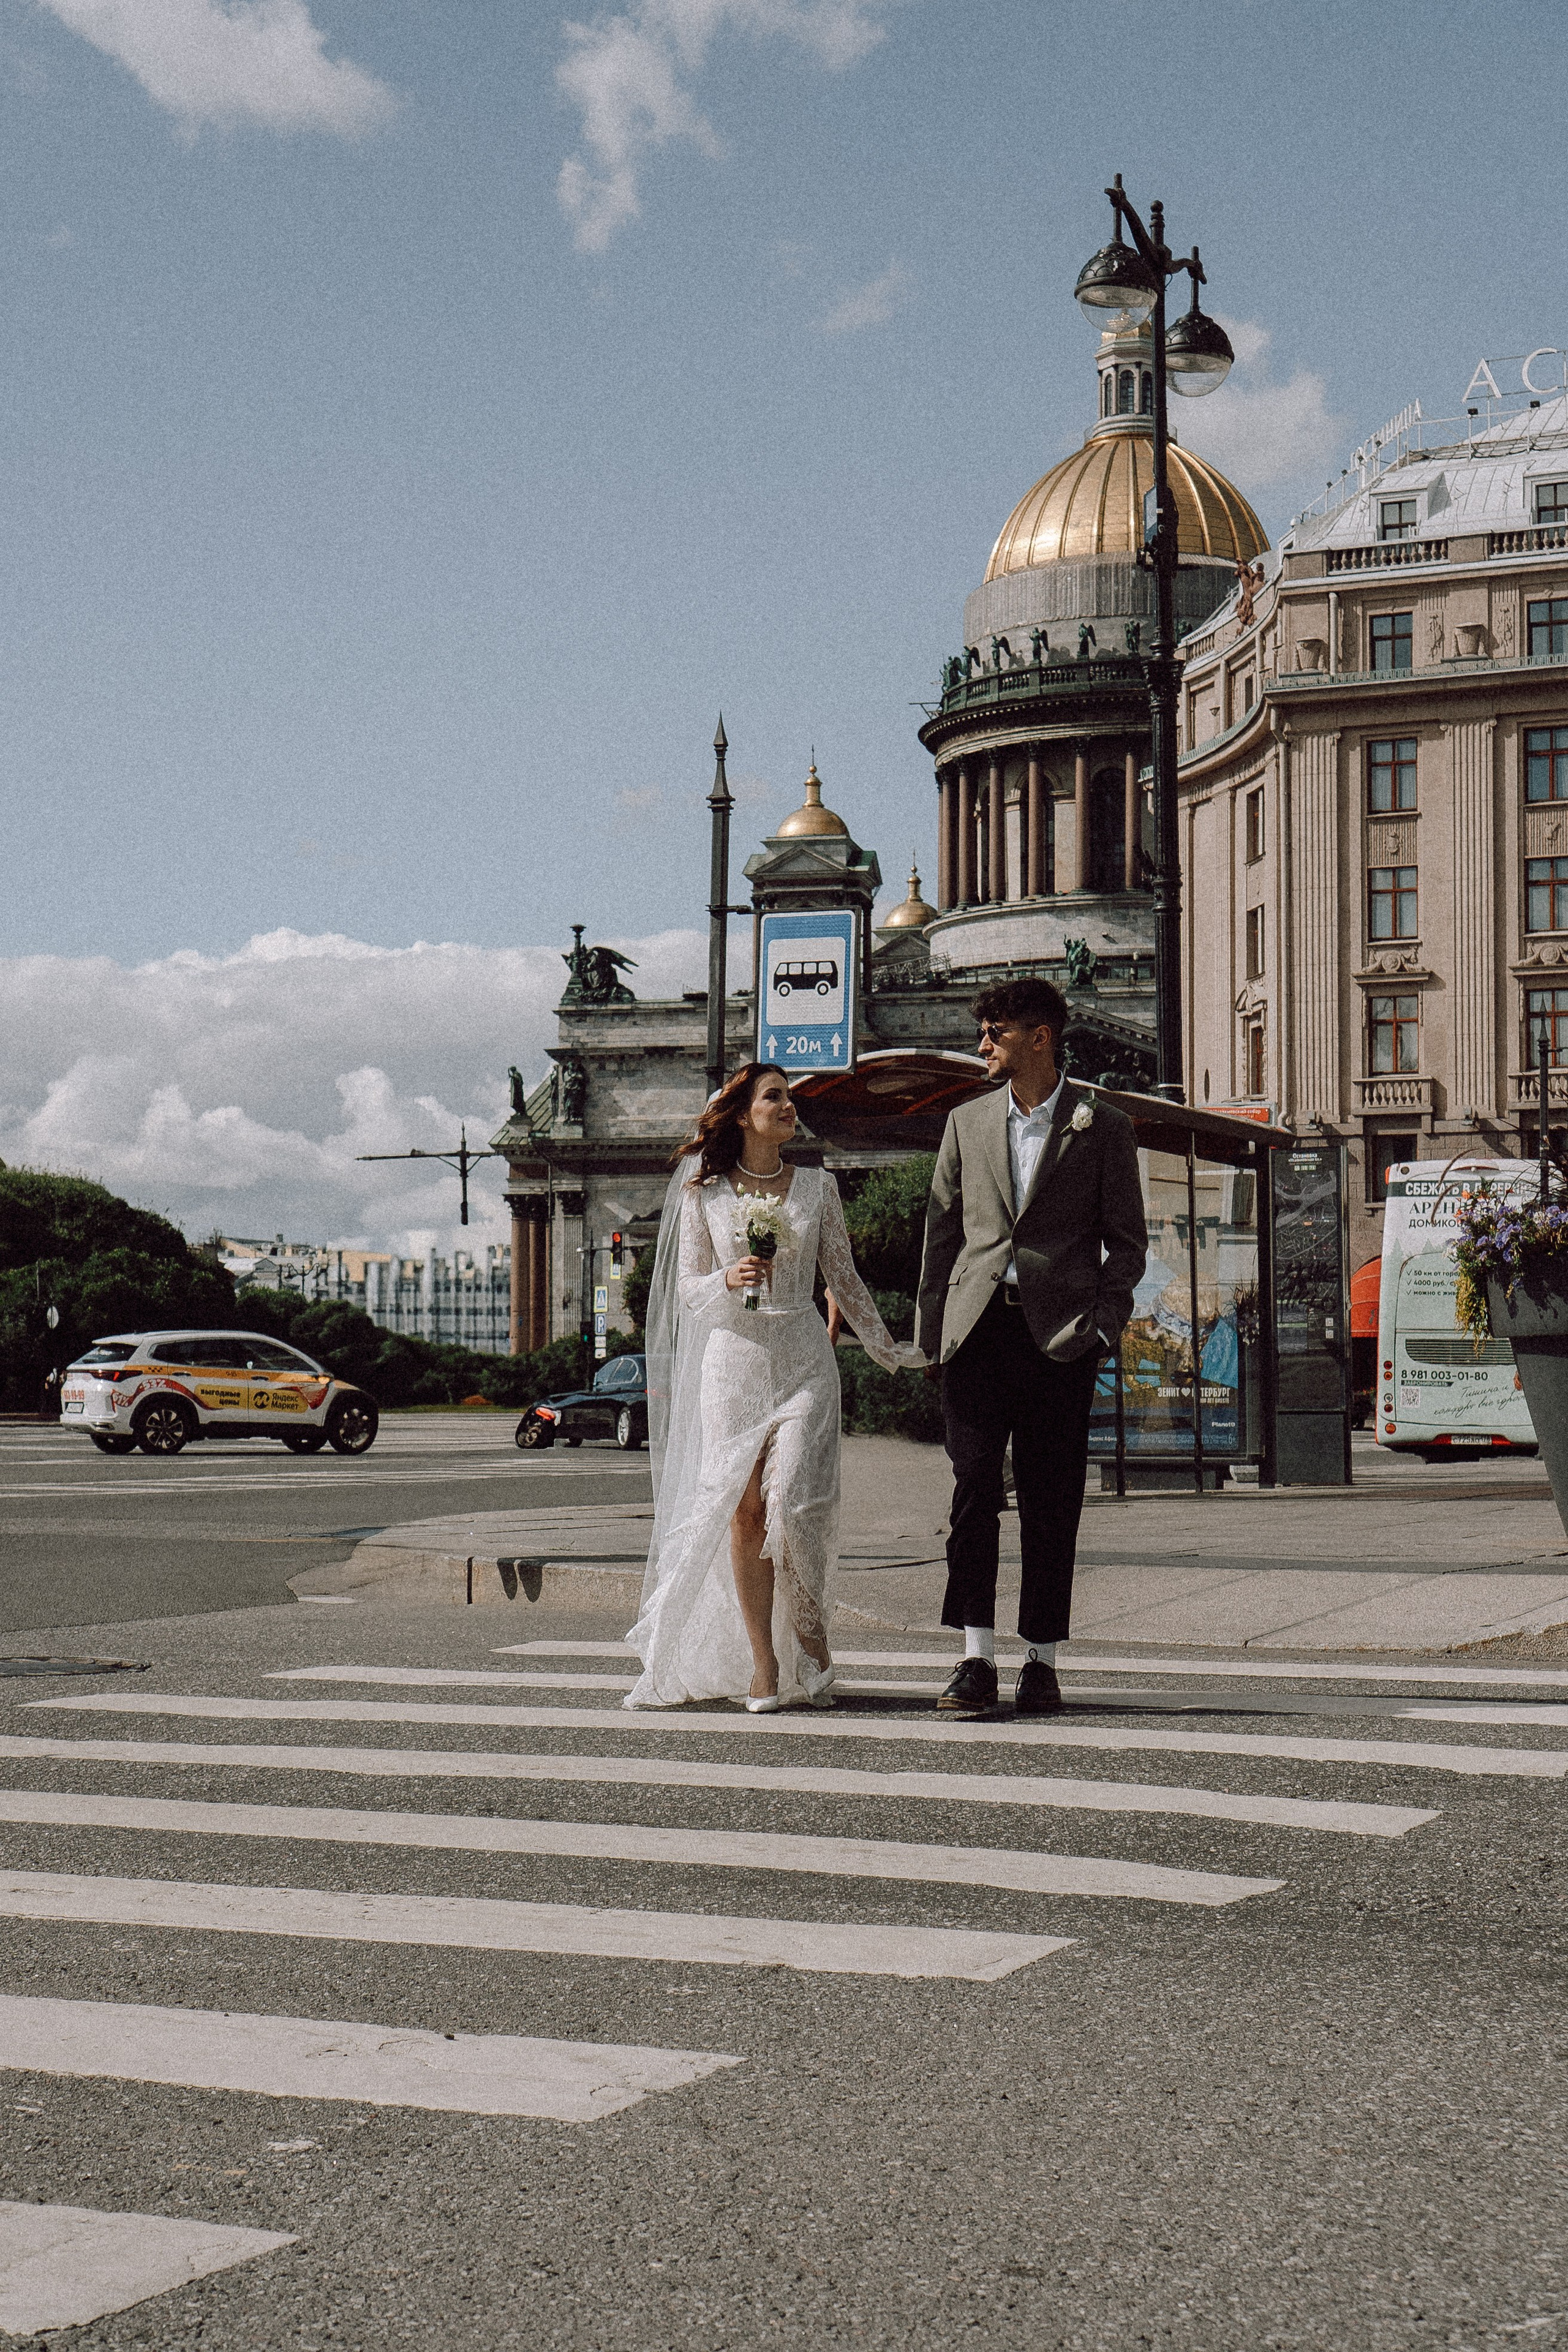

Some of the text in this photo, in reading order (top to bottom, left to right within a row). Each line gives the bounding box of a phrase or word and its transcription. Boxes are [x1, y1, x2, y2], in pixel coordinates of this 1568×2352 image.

[785, 1036, 821, 1054] 20м
[1405, 1182, 1460, 1196] СБЕЖАТЬ
[1401, 1370, 1488, 1381] 8 981 003-01-80
[200, 1389, 241, 1398] выгодные
[1158, 1387, 1231, 1397] ЗЕНИТ ТЕРБУРГ
[272, 1393, 298, 1403] Яндекс
[271, 1401, 299, 1411] Маркет
[1228, 1433, 1236, 1444] 6+
